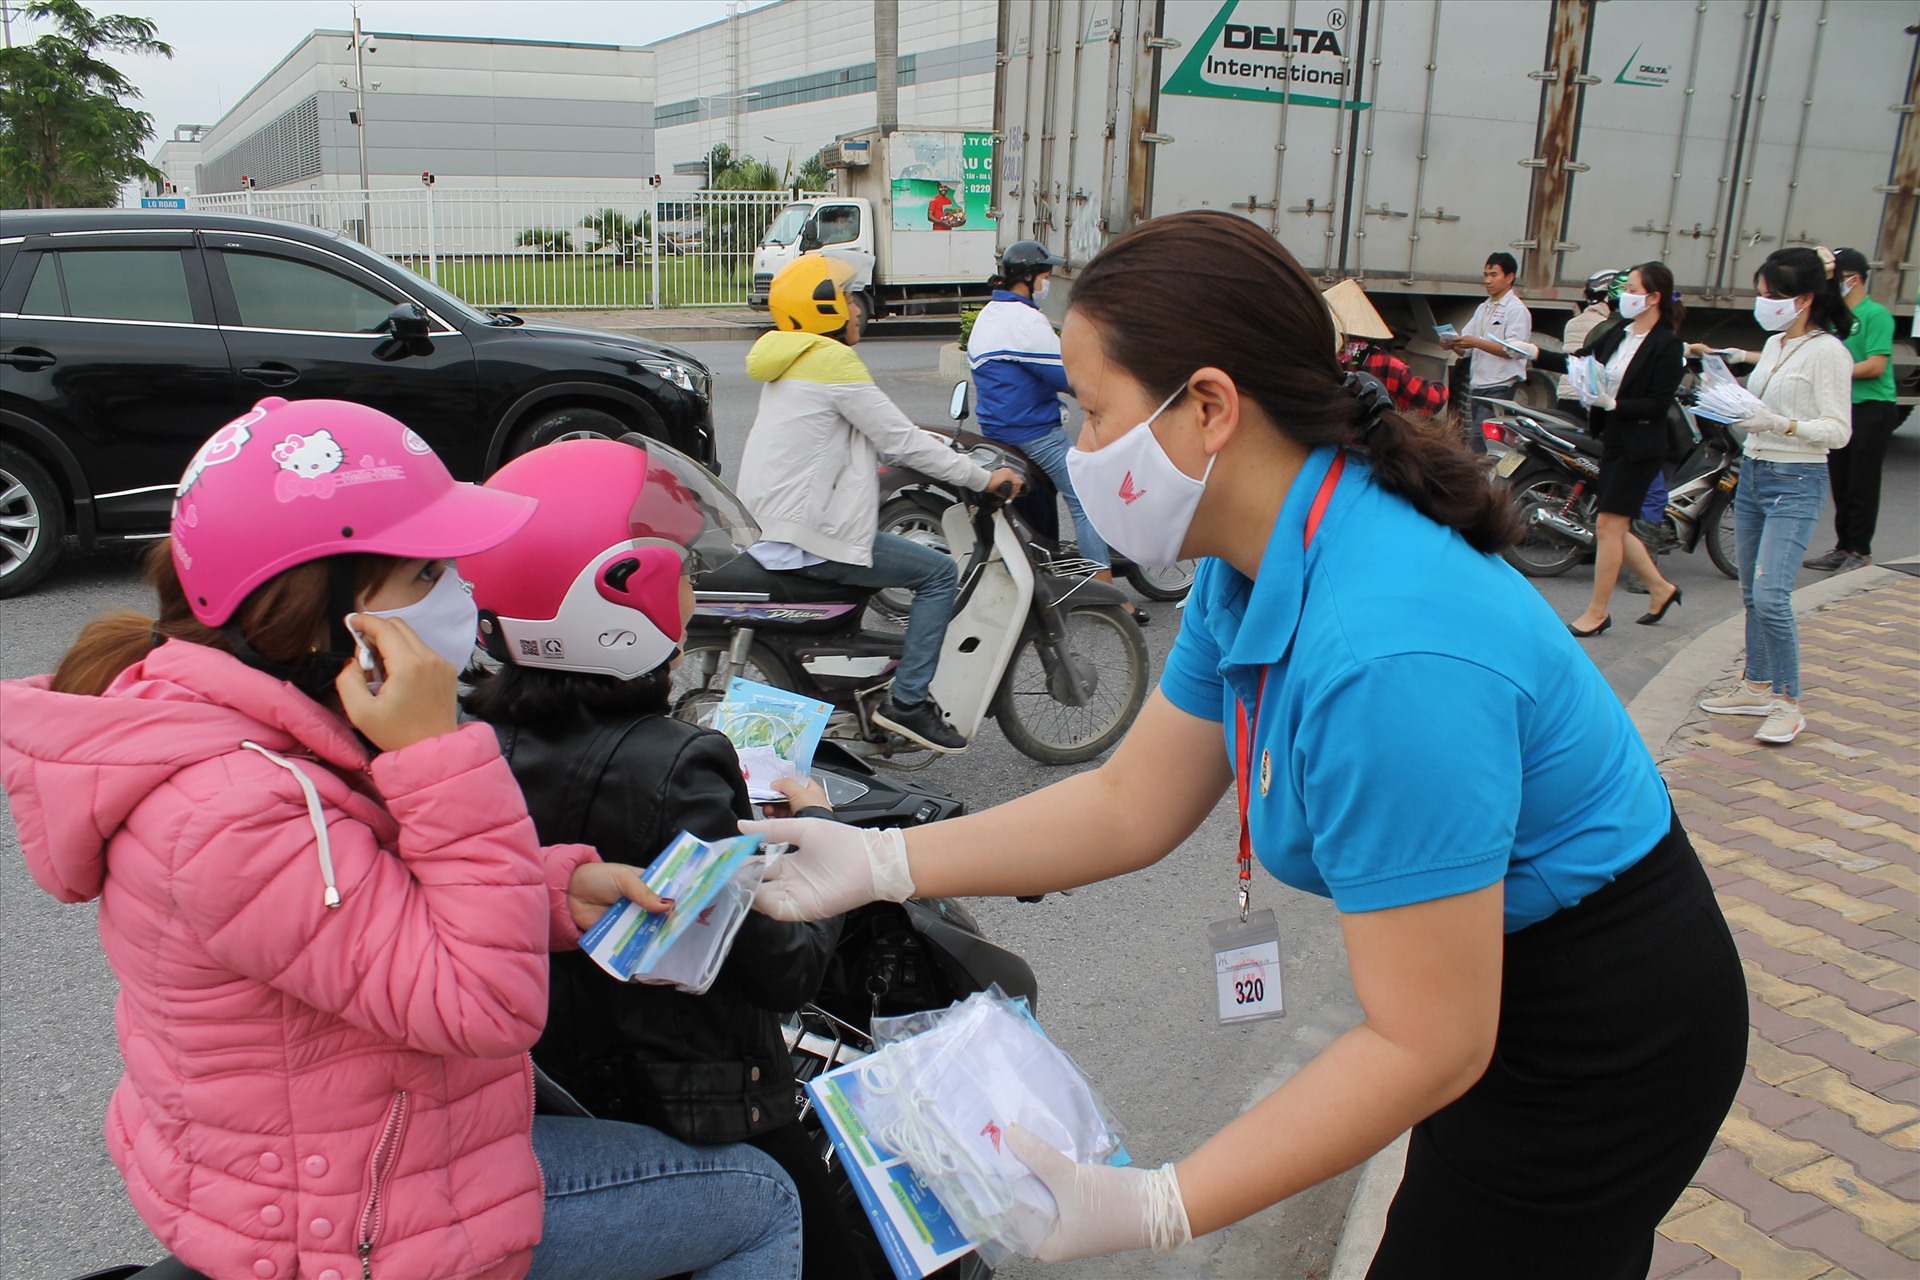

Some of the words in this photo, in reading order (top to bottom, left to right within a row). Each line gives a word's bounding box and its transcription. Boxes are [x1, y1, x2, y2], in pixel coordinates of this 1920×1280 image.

[1223, 23, 1342, 56] DELTA
[1206, 55, 1351, 87] International
[1640, 65, 1667, 75] DELTA
[968, 137, 979, 146] TY
[147, 200, 157, 208] LG
[158, 200, 178, 208] ROAD
[765, 608, 827, 619] Dream
[1235, 978, 1264, 1005] 320
